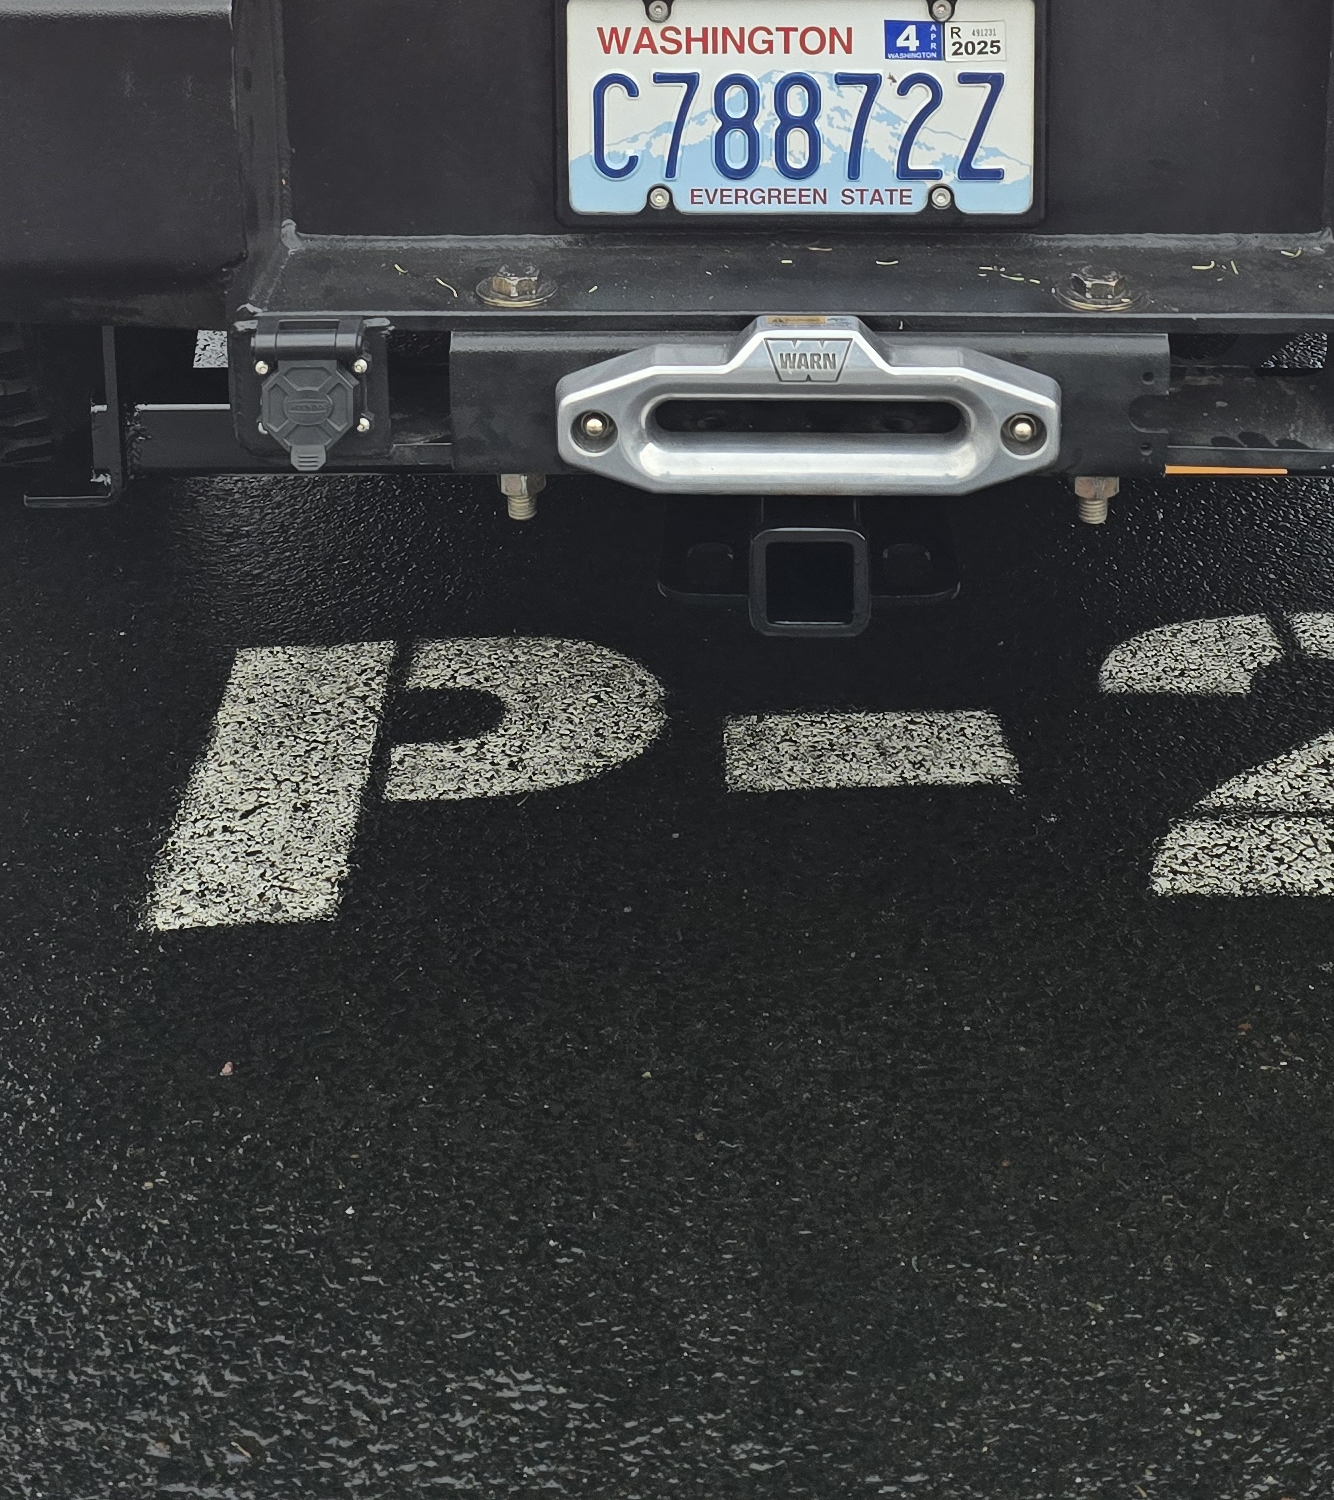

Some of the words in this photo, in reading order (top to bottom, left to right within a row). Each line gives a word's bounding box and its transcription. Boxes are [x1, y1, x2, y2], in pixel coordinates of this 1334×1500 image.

[597, 26, 853, 55] WASHINGTON
[896, 24, 920, 52] 4
[950, 26, 962, 39] R
[971, 28, 997, 37] 491231
[951, 40, 1002, 56] 2025
[592, 72, 1005, 181] C78872Z
[690, 188, 827, 206] EVERGREEN
[841, 188, 913, 206] STATE
[779, 352, 837, 370] WARN
